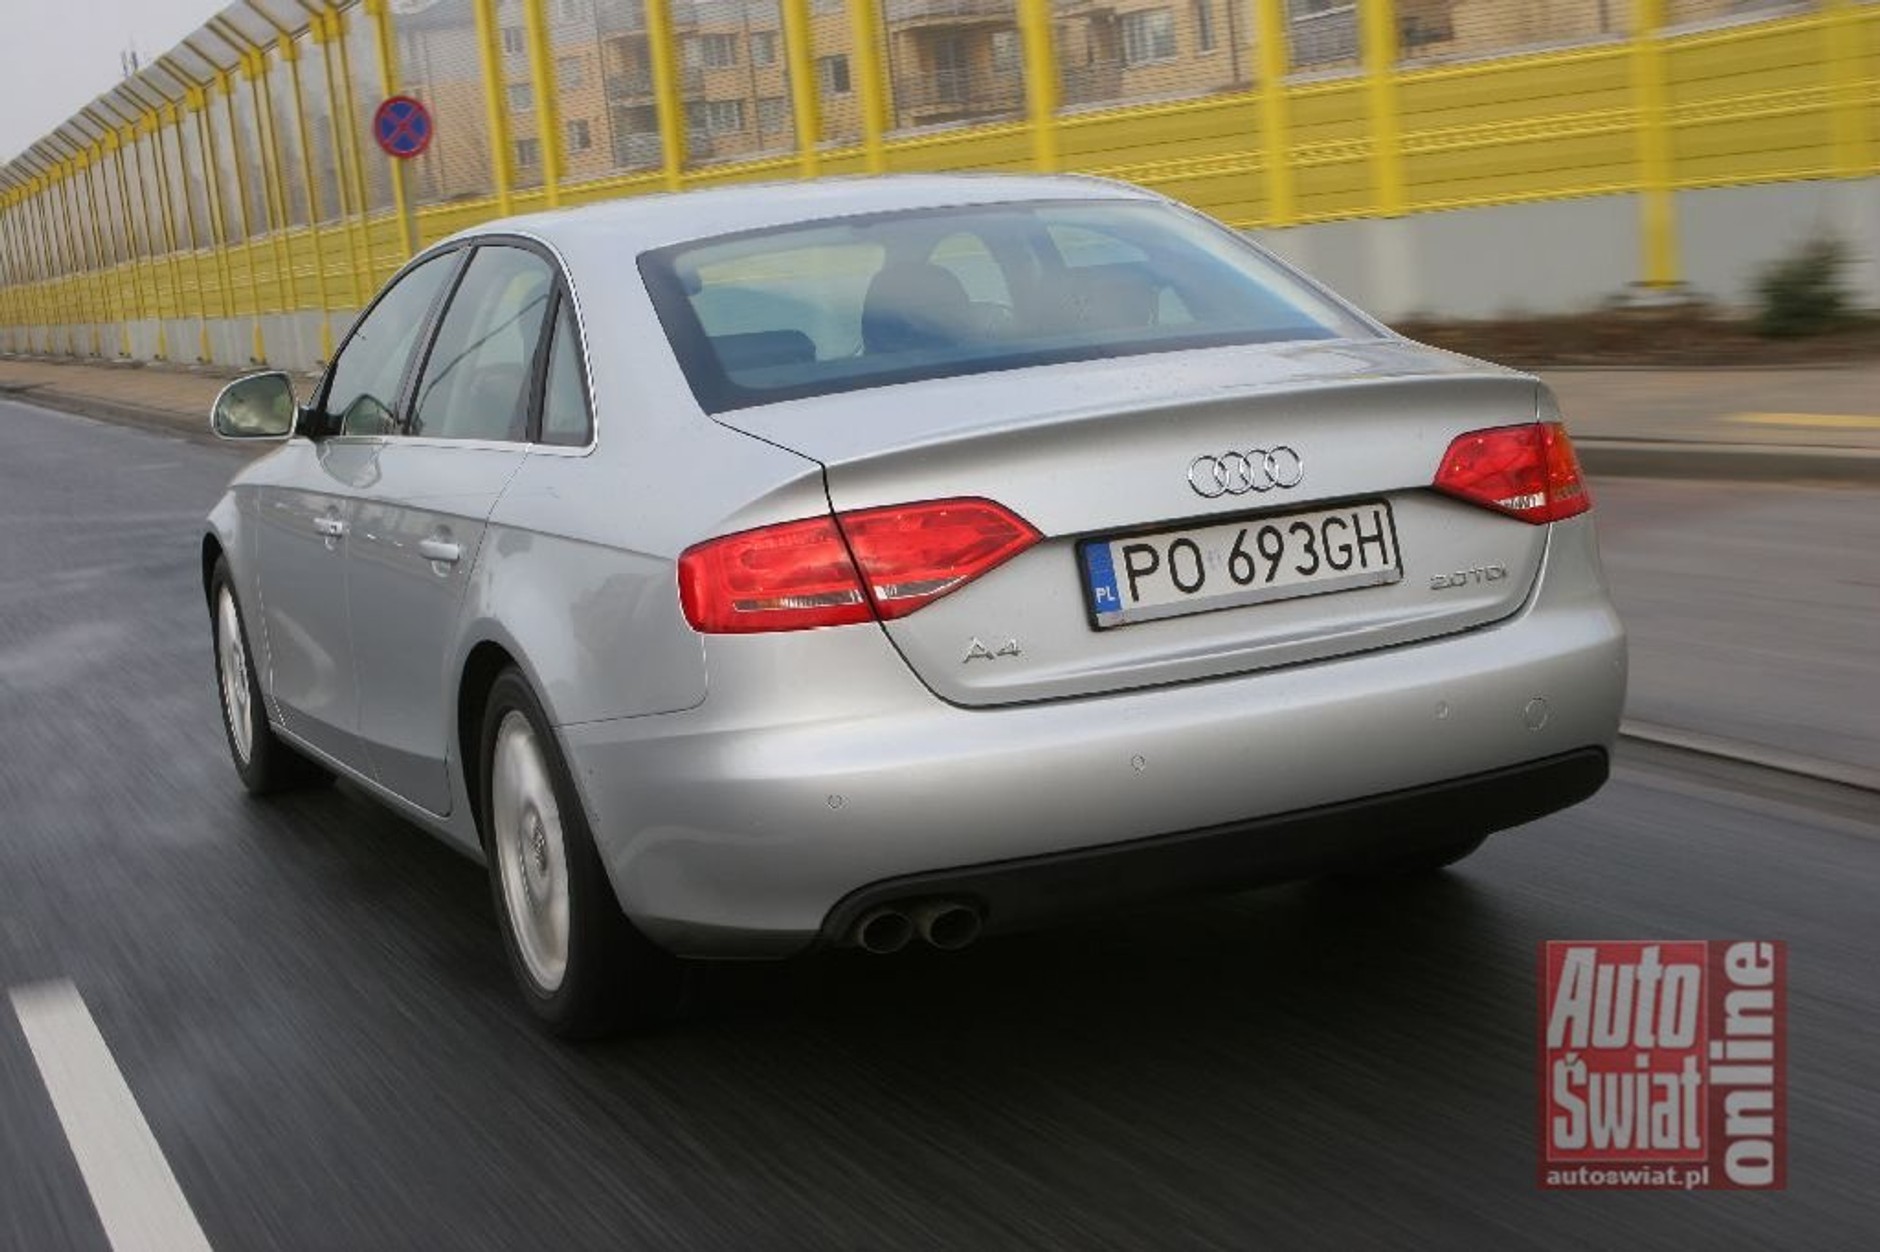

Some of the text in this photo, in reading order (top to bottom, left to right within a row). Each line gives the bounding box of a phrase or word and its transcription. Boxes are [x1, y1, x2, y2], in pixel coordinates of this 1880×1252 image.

[1122, 510, 1390, 602] PO 693GH
[1095, 586, 1116, 604] PL
[962, 636, 1022, 664] A4
